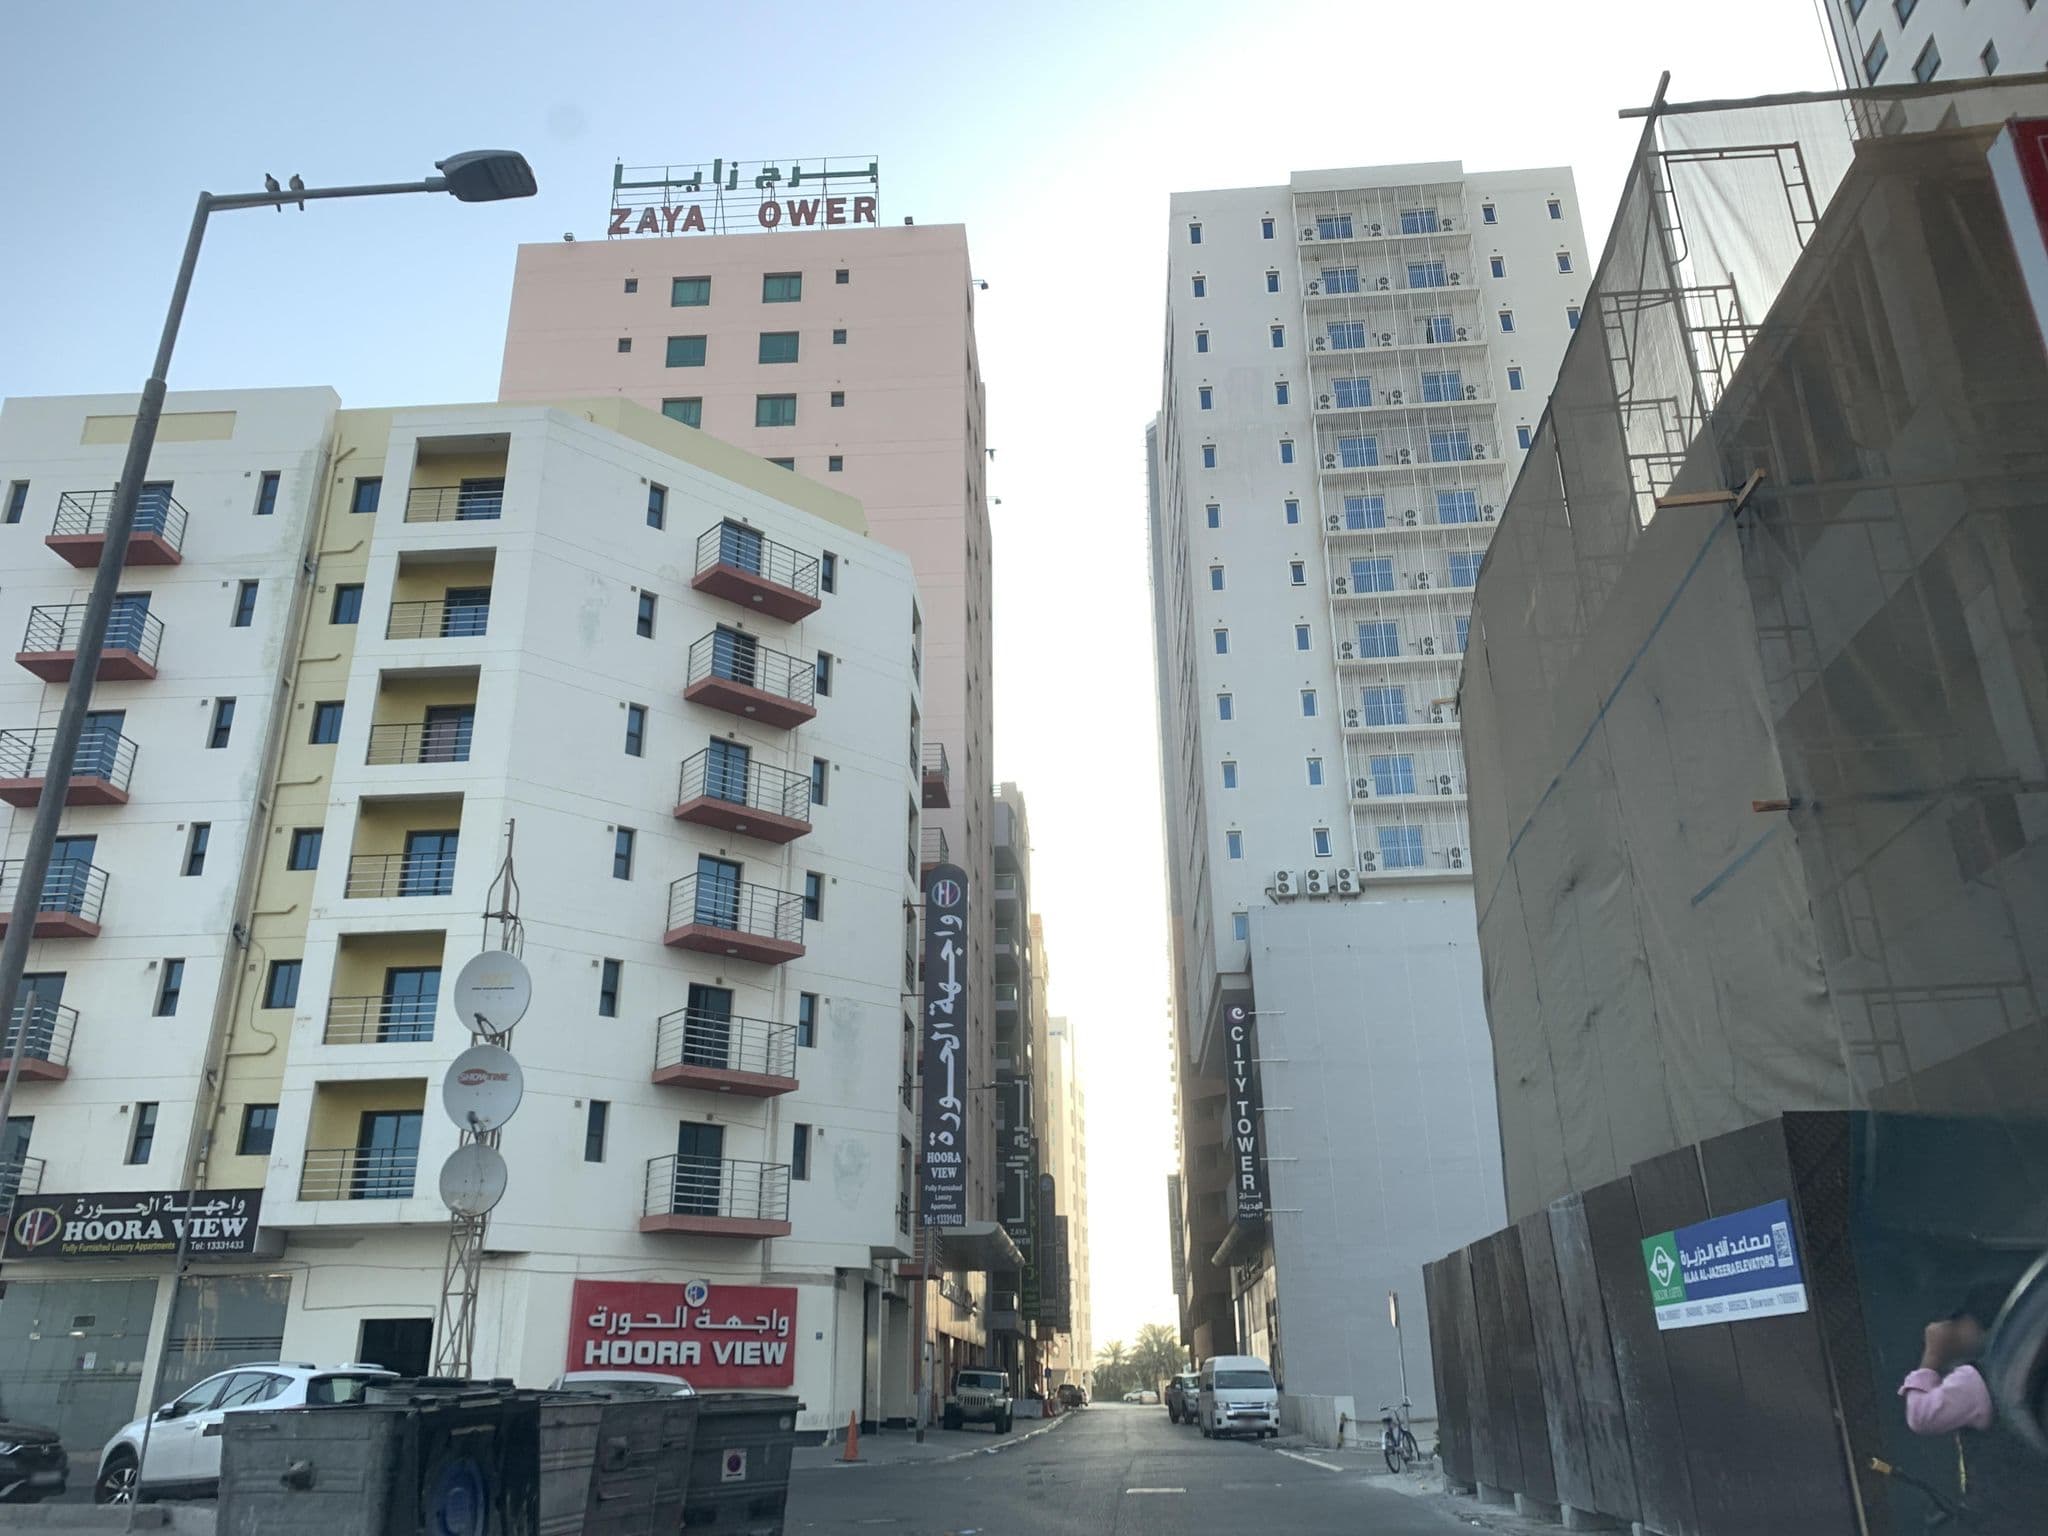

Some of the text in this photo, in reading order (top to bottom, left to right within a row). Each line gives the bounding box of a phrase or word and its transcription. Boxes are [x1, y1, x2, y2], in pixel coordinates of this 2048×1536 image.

[608, 205, 706, 235] ZAYA
[929, 914, 963, 1146] واجهة الحورة
[1231, 1026, 1256, 1191] CITY TOWER
[926, 1152, 961, 1163] HOORA
[931, 1167, 957, 1178] VIEW
[74, 1196, 160, 1219] الحورة
[62, 1217, 248, 1241] HOORA VIEW
[1735, 1254, 1775, 1274] ELEVATORS
[588, 1305, 789, 1337] واجهة الحورة
[584, 1340, 788, 1366] HOORA VIEW
